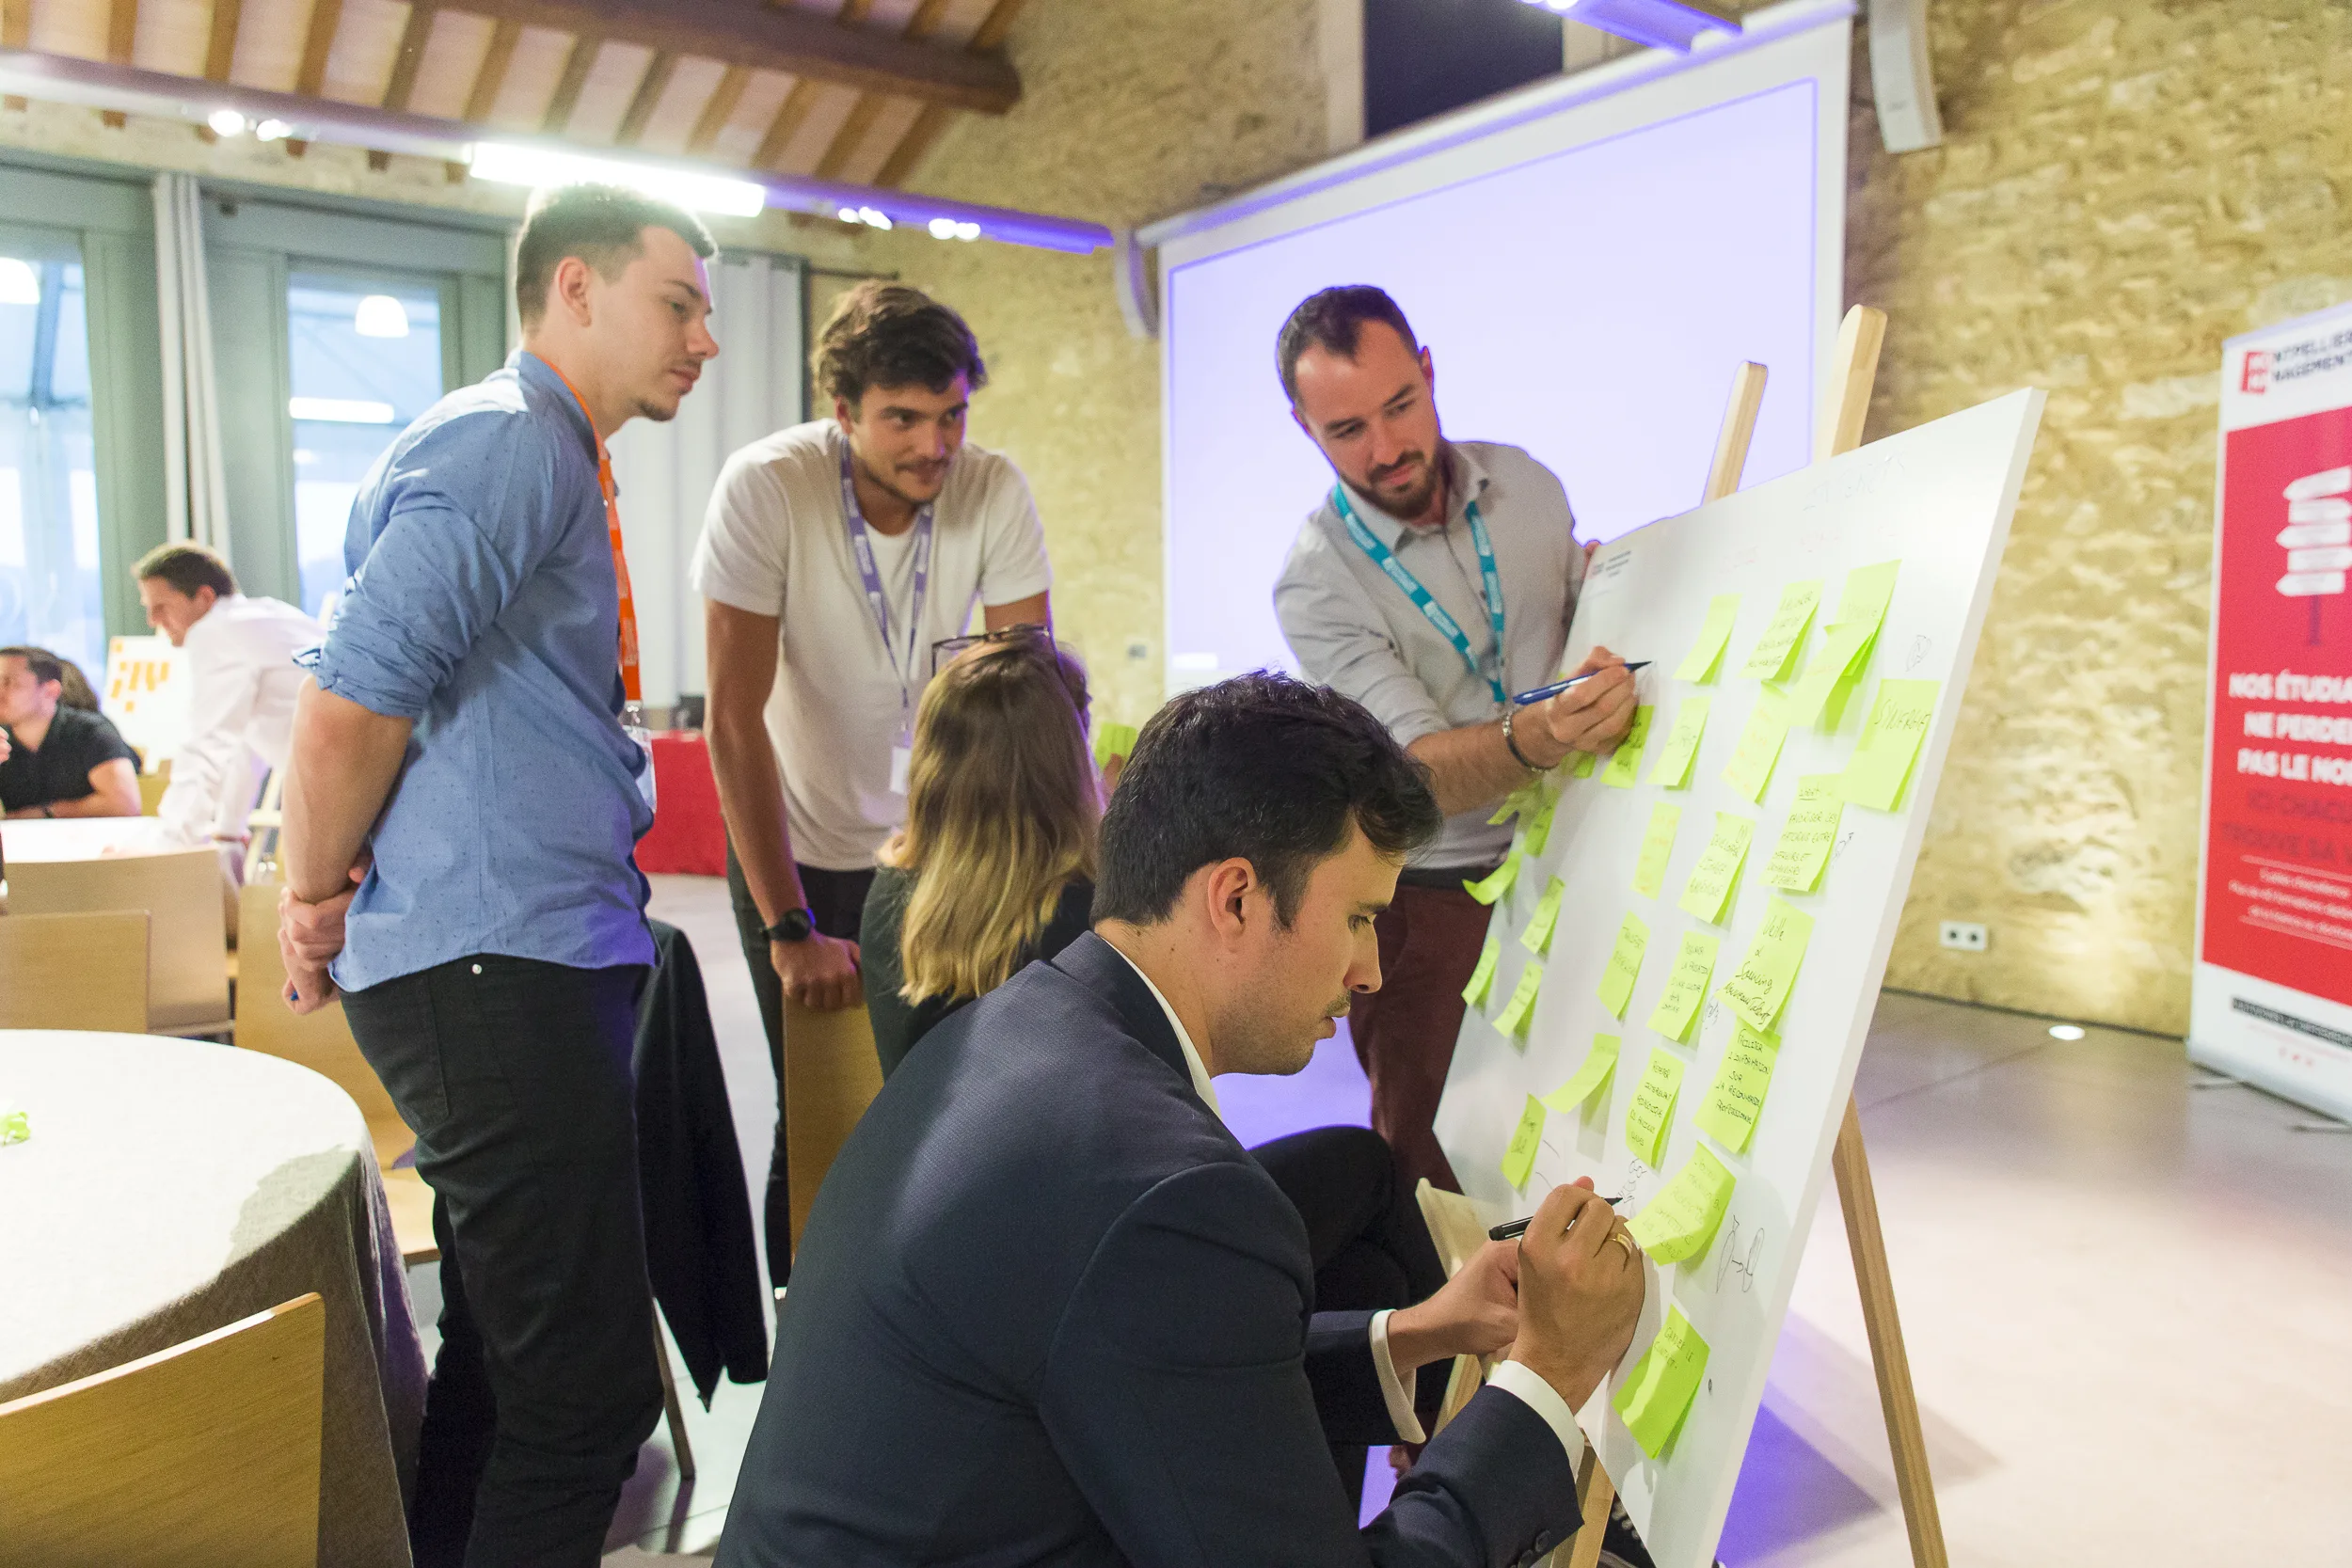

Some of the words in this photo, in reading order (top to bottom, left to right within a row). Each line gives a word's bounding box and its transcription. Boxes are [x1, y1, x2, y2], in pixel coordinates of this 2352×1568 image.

[2228, 671, 2272, 699] NOS
[2243, 710, 2274, 738] NE
[2236, 747, 2278, 777] PAS
[2280, 752, 2308, 781] LE
